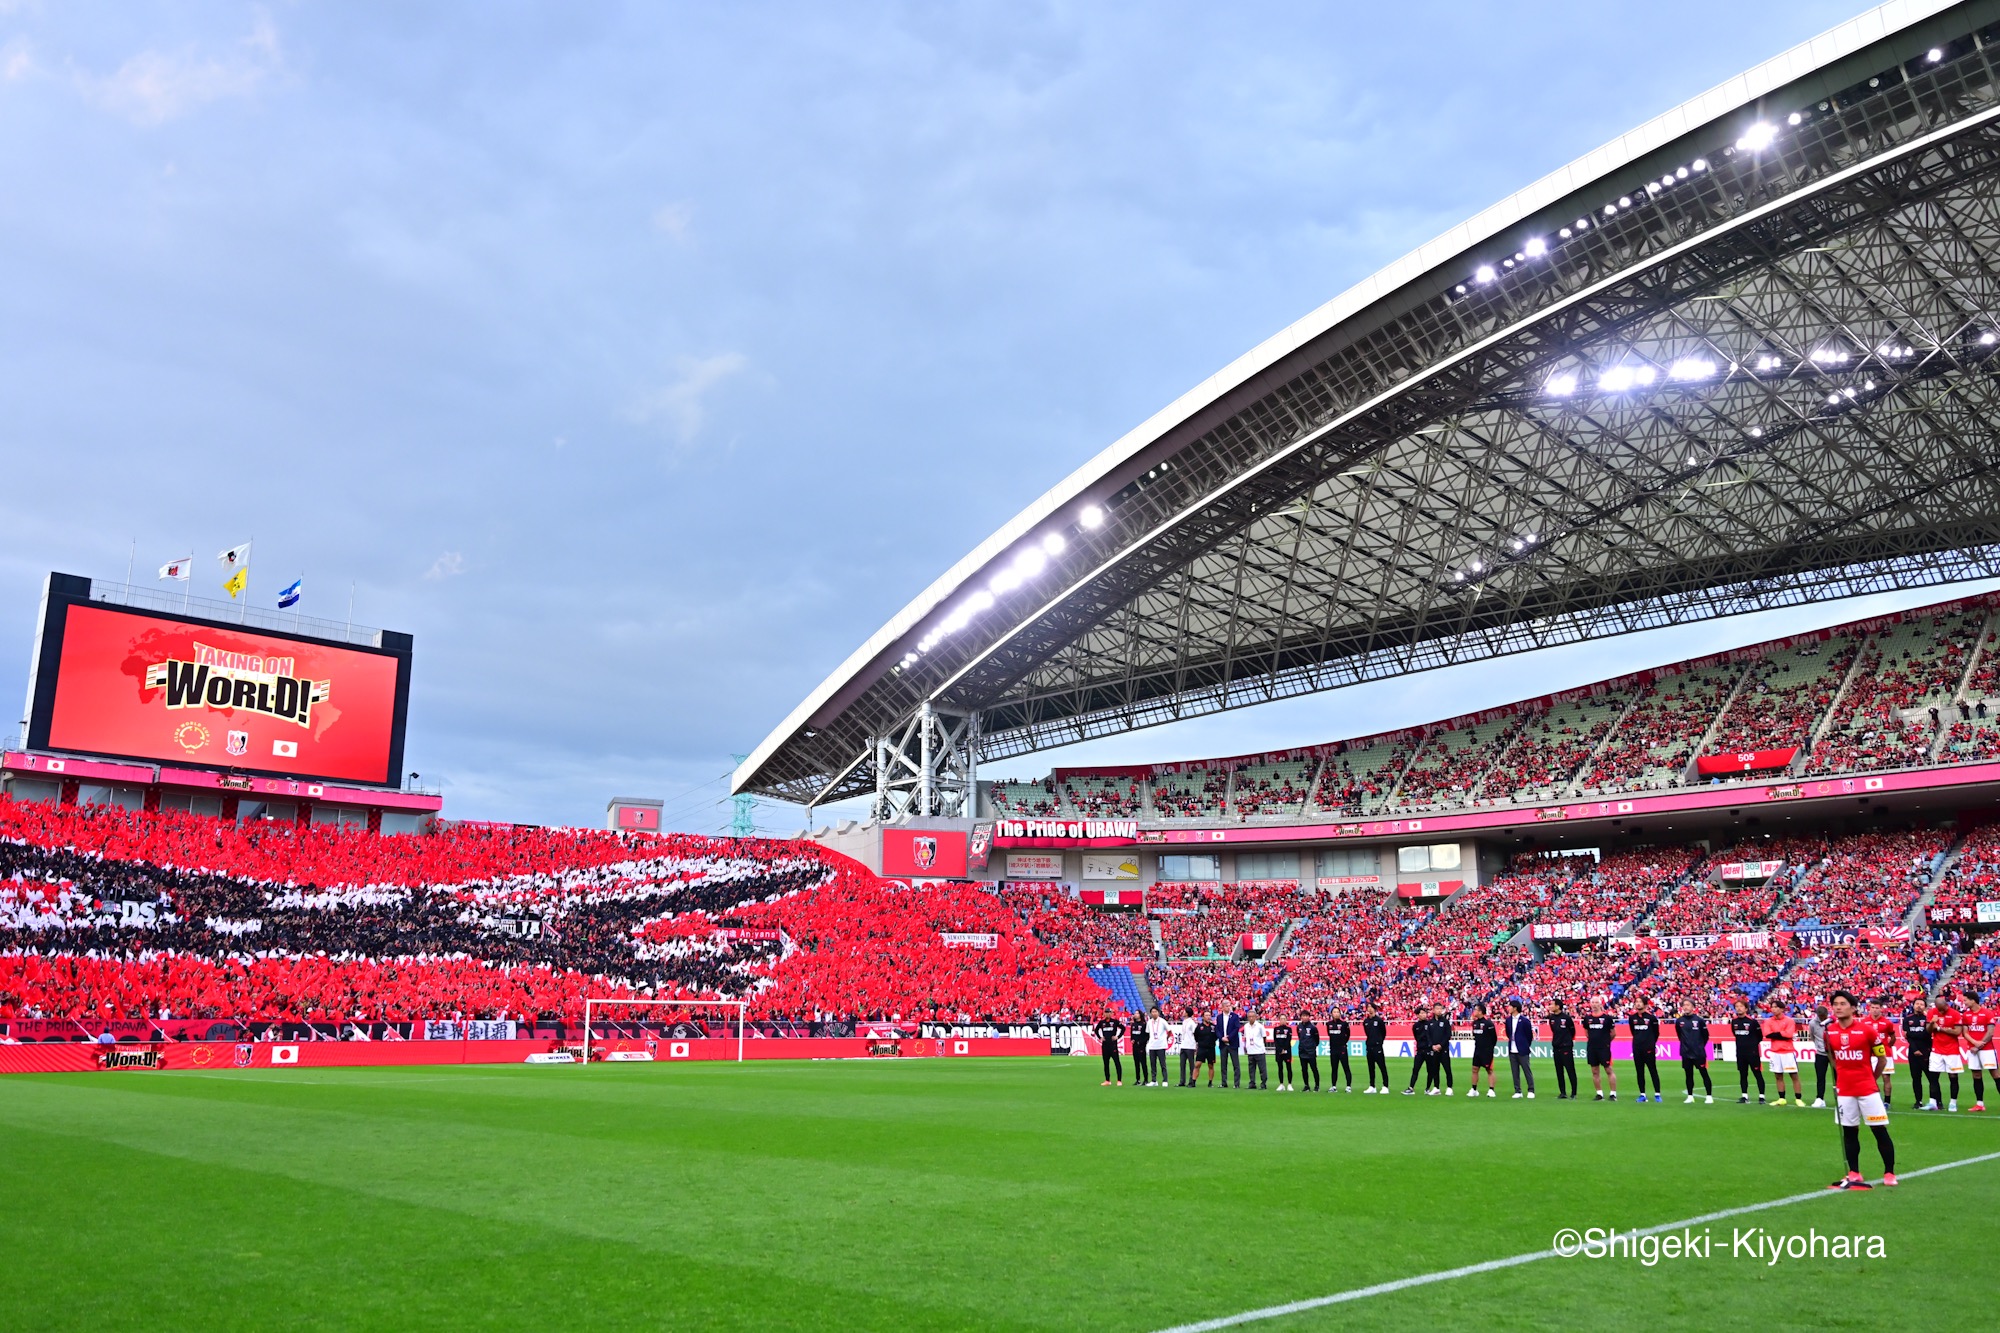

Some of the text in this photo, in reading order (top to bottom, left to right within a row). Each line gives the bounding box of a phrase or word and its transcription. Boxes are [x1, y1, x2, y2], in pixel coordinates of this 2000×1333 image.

[194, 643, 293, 677] TAKING ON
[167, 660, 312, 724] WORLD!
[1737, 752, 1755, 763] 505
[997, 821, 1024, 838] The
[1027, 821, 1066, 838] Pride
[1069, 822, 1084, 838] of
[1085, 821, 1137, 839] URAWA
[1796, 929, 1831, 937] MATHEUS
[1658, 939, 1668, 949] 9
[16, 1021, 43, 1032] THE
[48, 1021, 80, 1032] PRIDE
[88, 1021, 101, 1032] OF
[1834, 1050, 1863, 1060] POLUS
[1878, 1046, 1885, 1054] C
[106, 1051, 158, 1068] WORLD!
